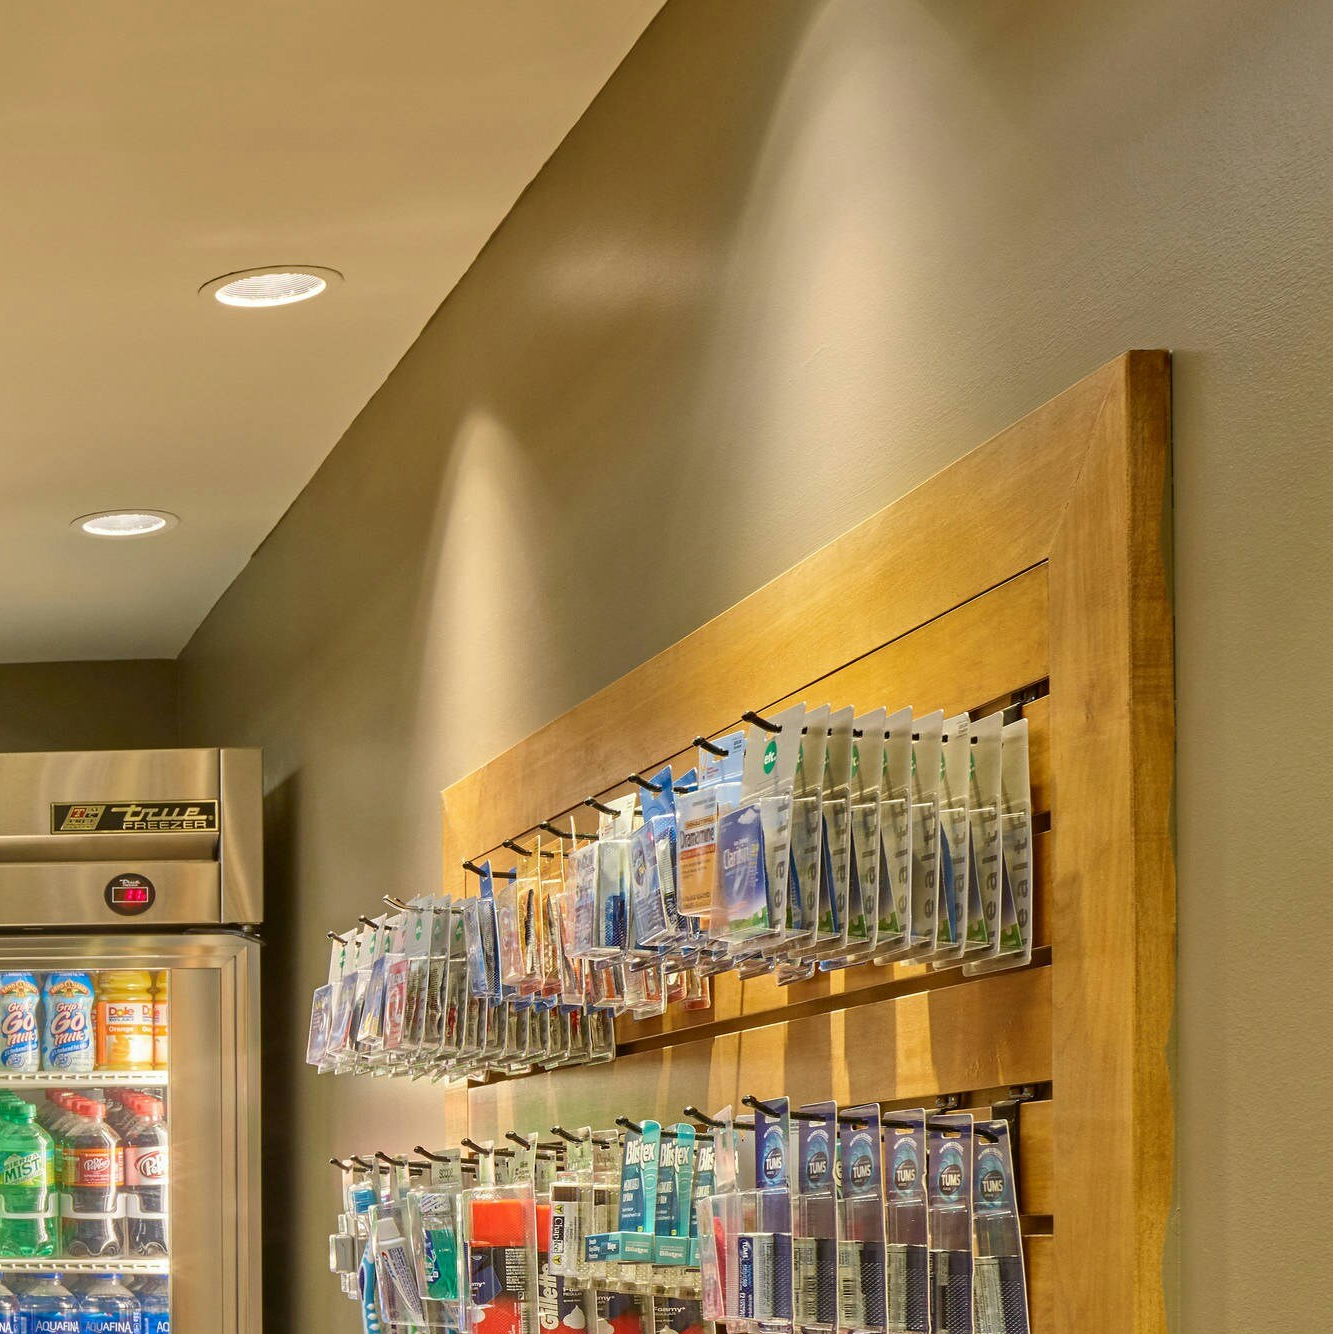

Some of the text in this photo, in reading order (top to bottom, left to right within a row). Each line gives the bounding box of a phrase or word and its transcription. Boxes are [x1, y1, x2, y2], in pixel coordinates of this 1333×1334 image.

[123, 821, 206, 830] FREEZER
[109, 1006, 134, 1016] Dole
[109, 1025, 134, 1034] Orange
[5, 1154, 39, 1169] SIERRA
[625, 1140, 656, 1169] Blistex
[659, 1142, 689, 1171] Blistex
[697, 1147, 715, 1171] Blis
[765, 1156, 783, 1170] TUMS
[809, 1160, 826, 1174] TUMS
[4, 1160, 41, 1182] MIST
[852, 1164, 871, 1177] TUMS
[897, 1168, 915, 1182] TUMS
[941, 1172, 960, 1186] TUMS
[982, 1178, 1003, 1192] TUMS
[35, 1320, 79, 1333] AQUAFINA
[86, 1320, 133, 1334] AQUAFINA
